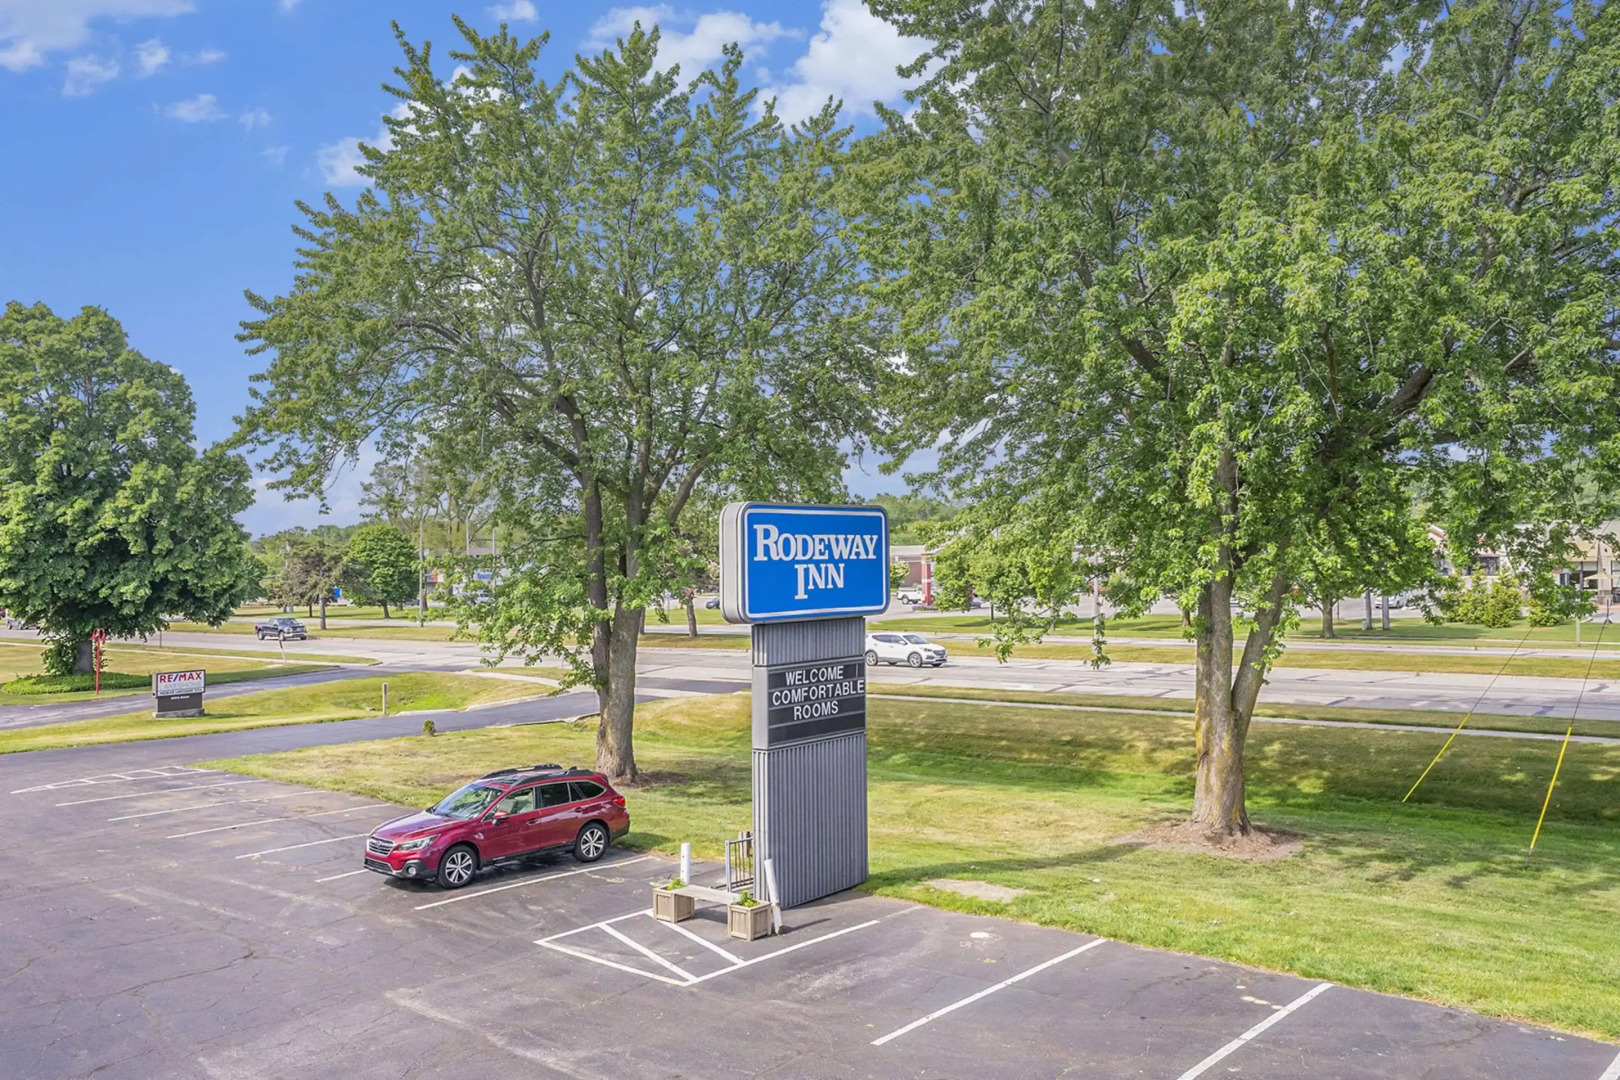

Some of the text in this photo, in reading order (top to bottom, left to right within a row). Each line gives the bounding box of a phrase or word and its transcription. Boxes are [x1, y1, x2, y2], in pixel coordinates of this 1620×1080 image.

[753, 524, 878, 561] RODEWAY
[794, 563, 845, 600] INN
[159, 672, 202, 683] RE/MAX
[785, 665, 844, 686] WELCOME
[772, 680, 865, 706] COMFORTABLE
[793, 700, 839, 721] ROOMS
